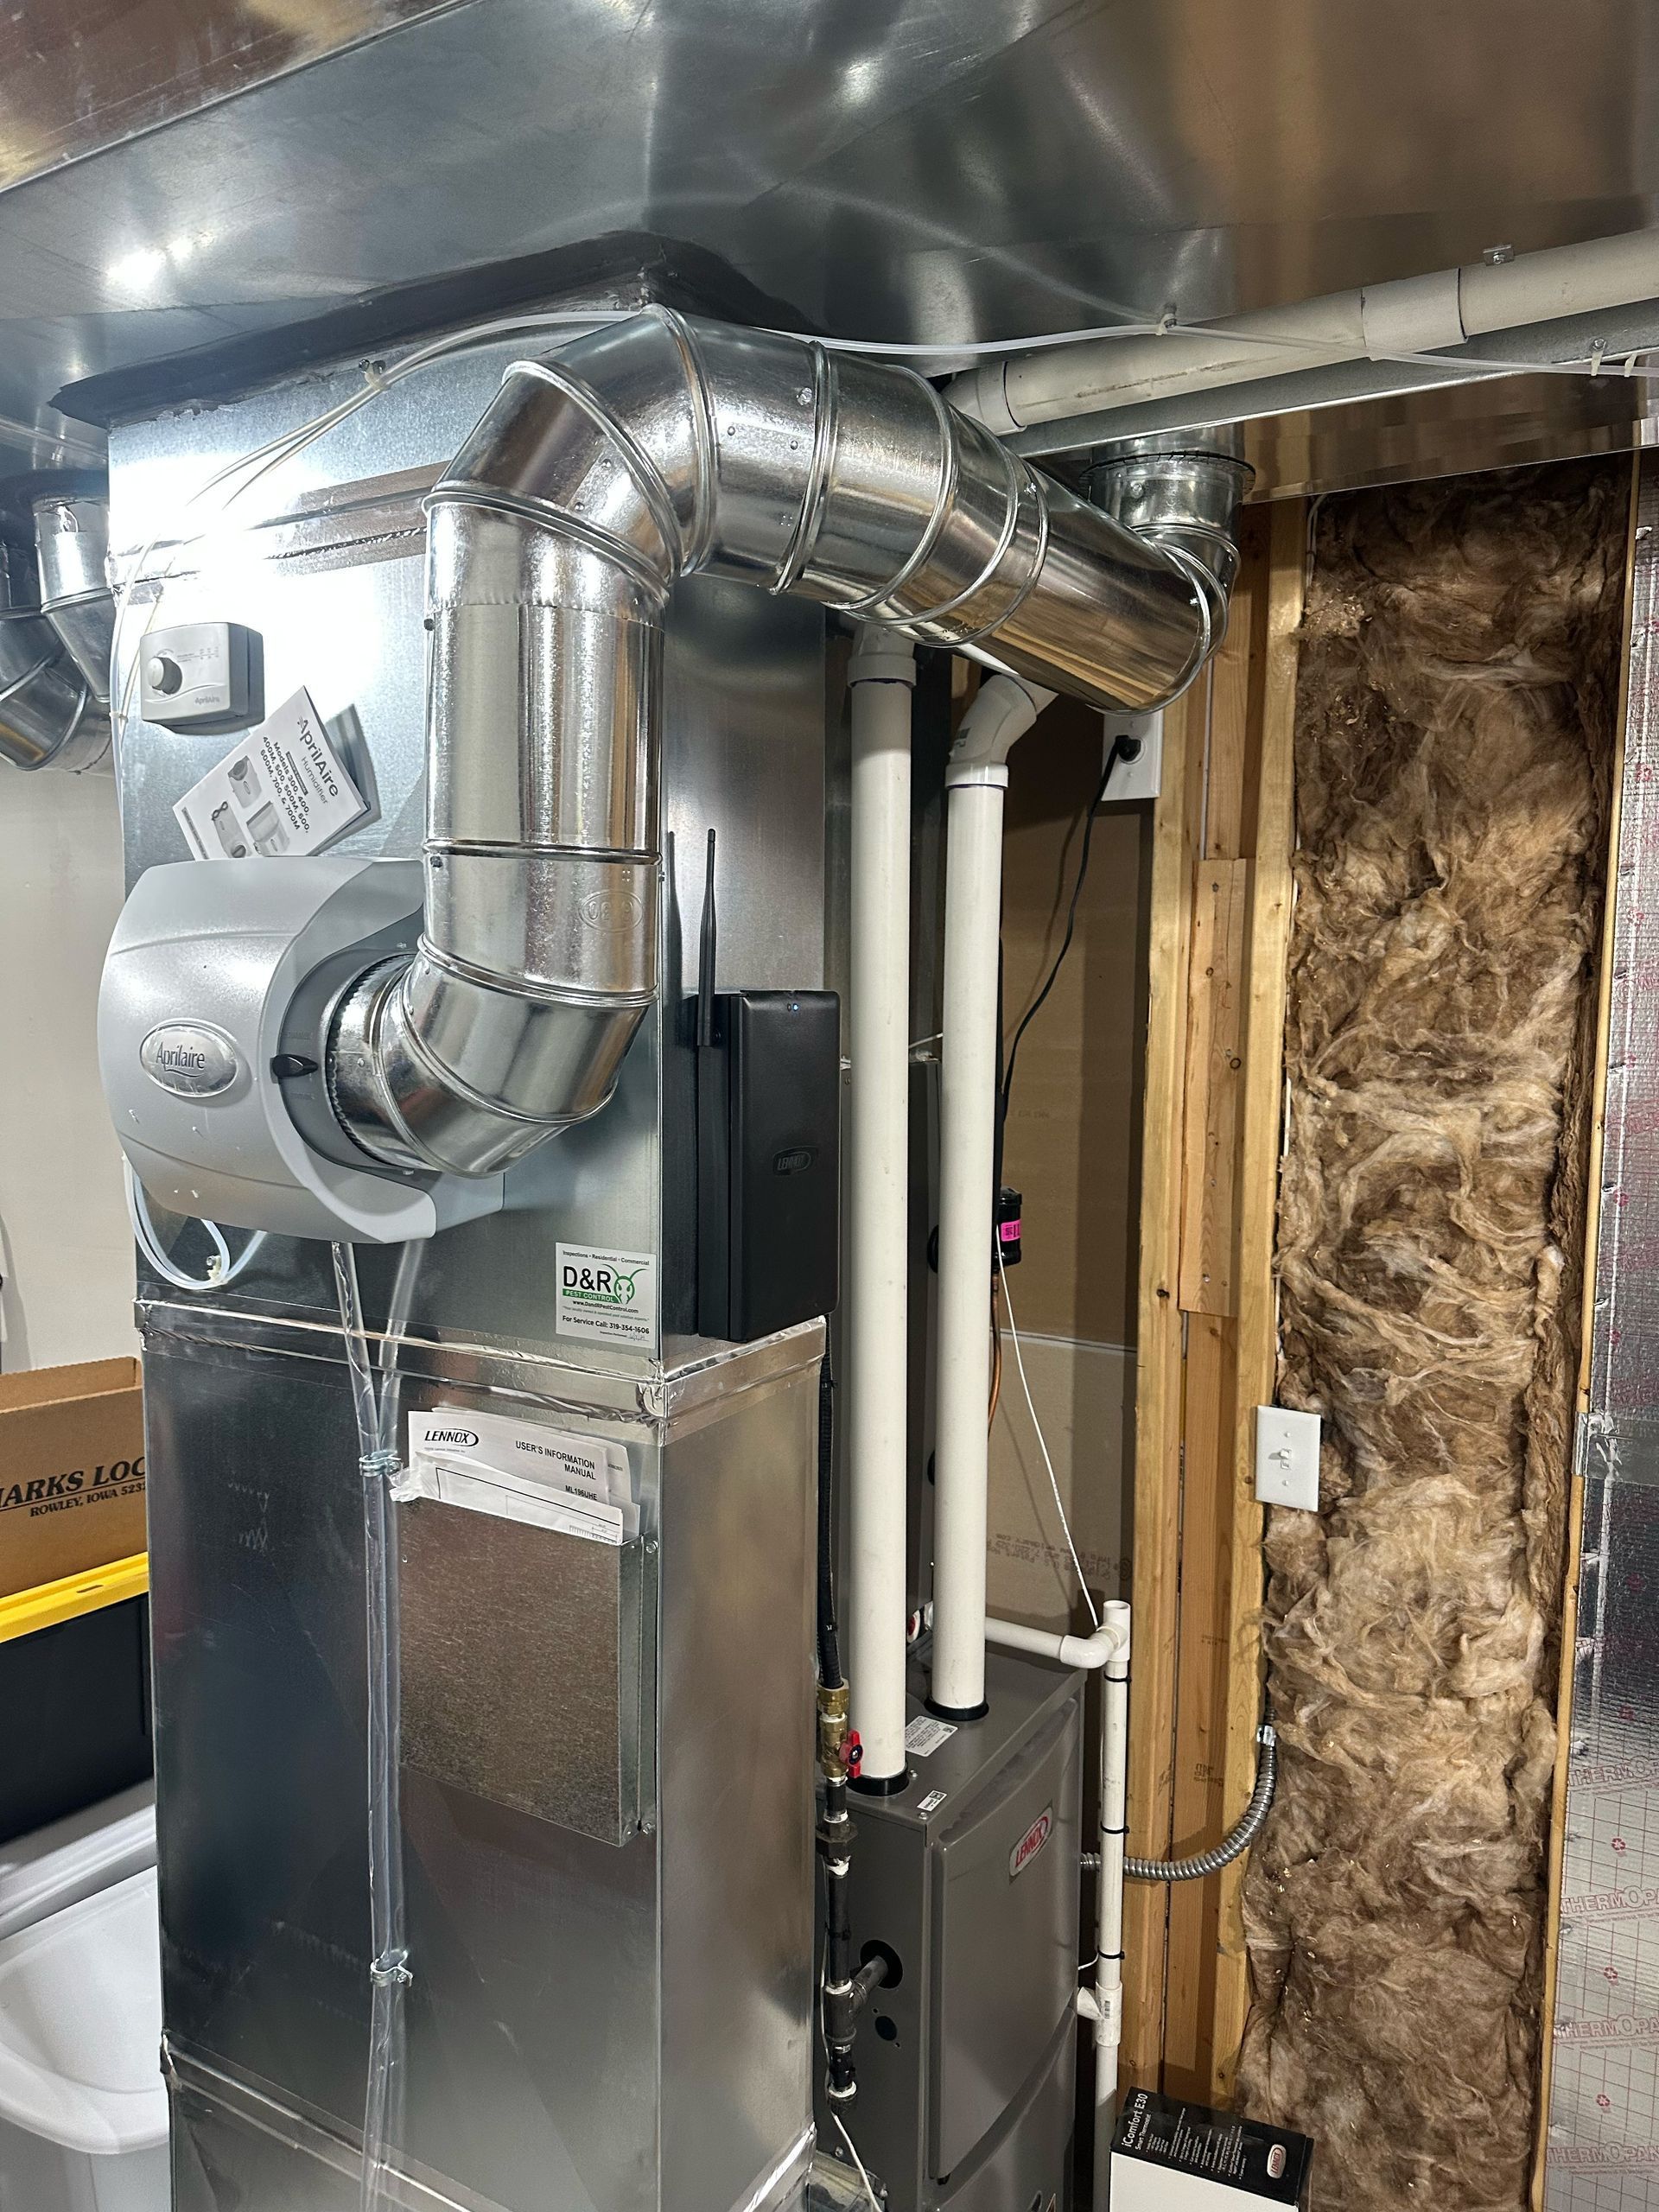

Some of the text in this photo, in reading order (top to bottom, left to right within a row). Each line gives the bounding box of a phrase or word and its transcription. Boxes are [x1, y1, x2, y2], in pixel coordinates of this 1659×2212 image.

[297, 717, 340, 797] AprilAire
[263, 736, 276, 765] 400M,
[275, 763, 285, 785] 500,
[283, 785, 299, 813] 500M,
[273, 741, 289, 775] Models
[288, 774, 298, 795] 300,
[297, 796, 309, 816] 400,
[302, 756, 328, 804] Humidifier
[272, 776, 283, 797] 700,
[285, 804, 301, 830] 700M
[156, 1041, 206, 1070] Aprilaire
[620, 1257, 650, 1266] Commercial
[563, 1265, 612, 1294] D&R
[566, 1289, 614, 1303] PEST CONTROL
[574, 1317, 594, 1326] Service
[595, 1319, 607, 1328] Call:
[609, 1322, 650, 1334] 319-354-1606
[424, 1430, 470, 1444] LENNOX
[515, 1440, 543, 1455] USER'S
[544, 1448, 595, 1470] INFORMATION
[564, 1463, 596, 1480] MANUAL
[0, 1470, 84, 1508] ARKS
[30, 1496, 84, 1517] ROWLEY,
[86, 1489, 118, 1503] IOWA
[565, 1484, 598, 1501] ML196UHE
[1015, 1823, 1043, 1868] LENNOX
[1121, 2093, 1148, 2148] iComfort E30
[1135, 2133, 1145, 2151] Smart
